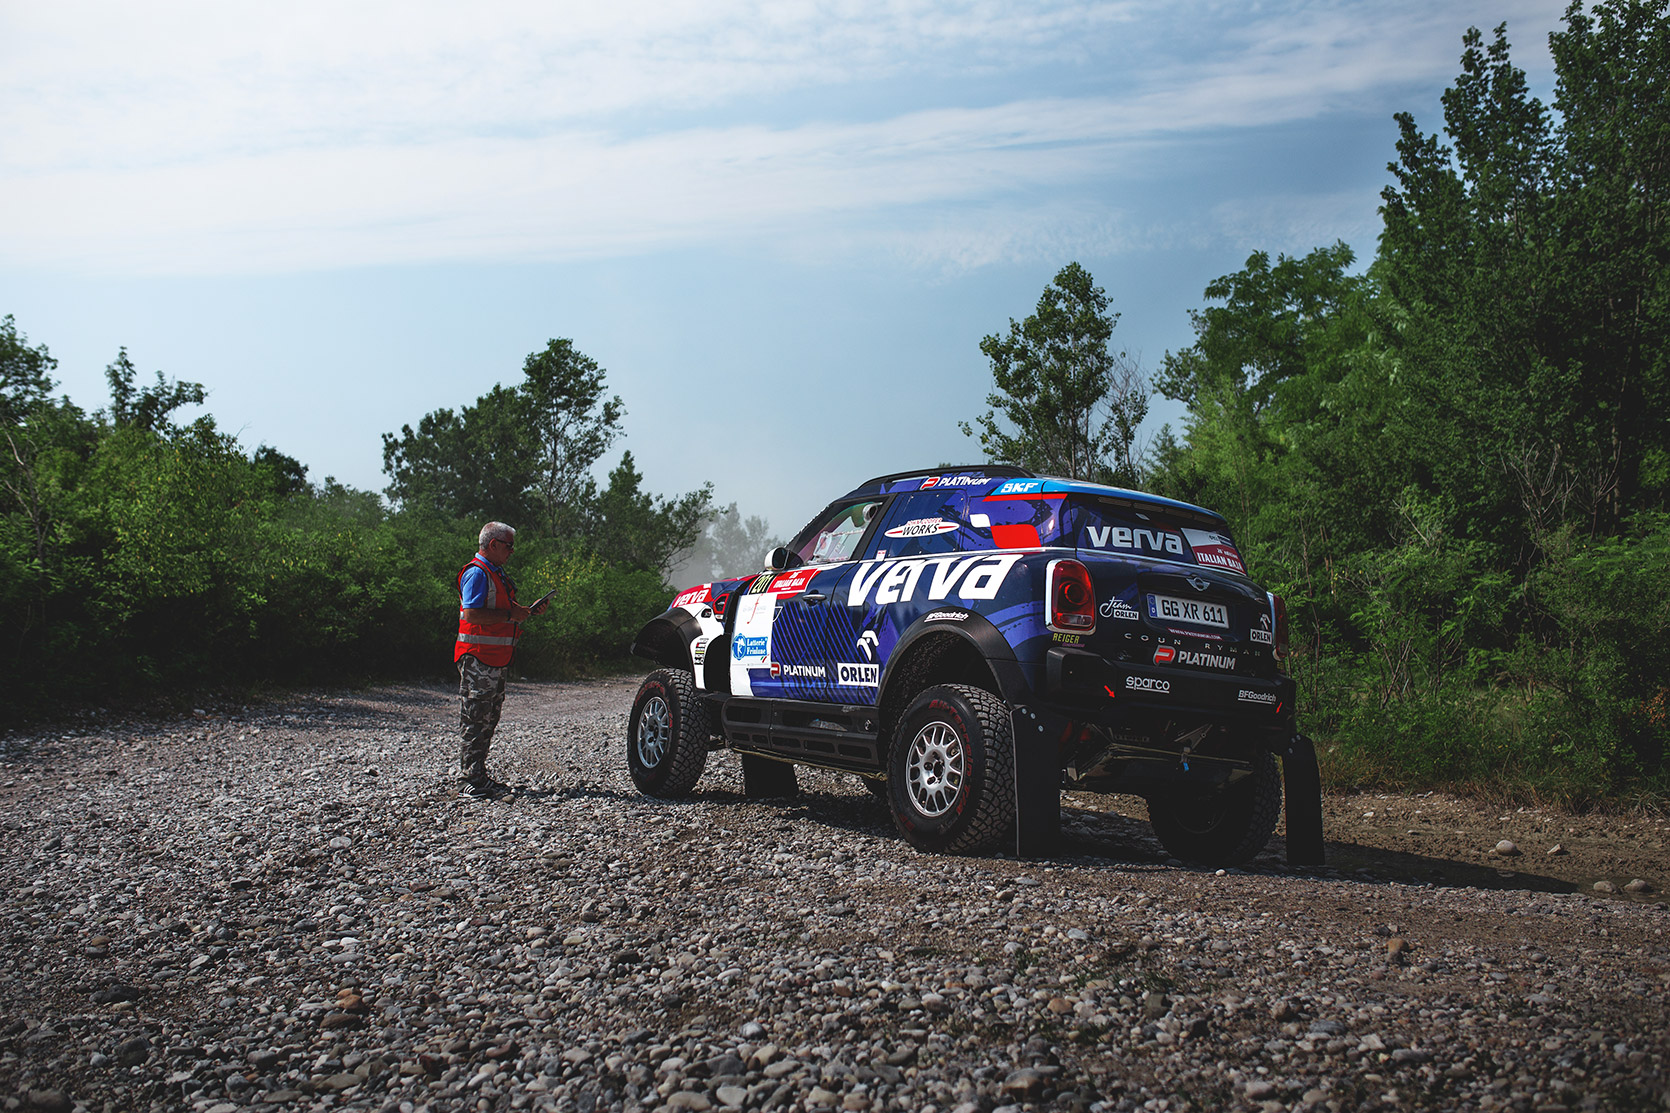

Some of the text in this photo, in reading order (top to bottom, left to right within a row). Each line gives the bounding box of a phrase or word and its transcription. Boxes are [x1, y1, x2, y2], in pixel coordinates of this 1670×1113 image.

[938, 476, 992, 487] PLATINUM
[1000, 482, 1039, 493] SKF
[902, 523, 940, 536] WORKS
[1086, 526, 1184, 555] verva
[1196, 552, 1244, 572] ITALIAN BAJA
[751, 574, 775, 594] 201
[847, 554, 1024, 607] verva
[673, 588, 709, 608] verva
[1115, 610, 1138, 619] ORLEN
[1161, 599, 1225, 624] GG XR 611
[1052, 632, 1080, 644] REIGER
[1124, 632, 1261, 657] COUNRYMAN
[1251, 631, 1271, 643] ORLEN
[1178, 650, 1236, 670] PLATINUM
[783, 664, 826, 678] PLATINUM
[840, 666, 878, 684] ORLEN
[1125, 675, 1171, 691] sparco
[1238, 689, 1277, 702] BFGoodrich
